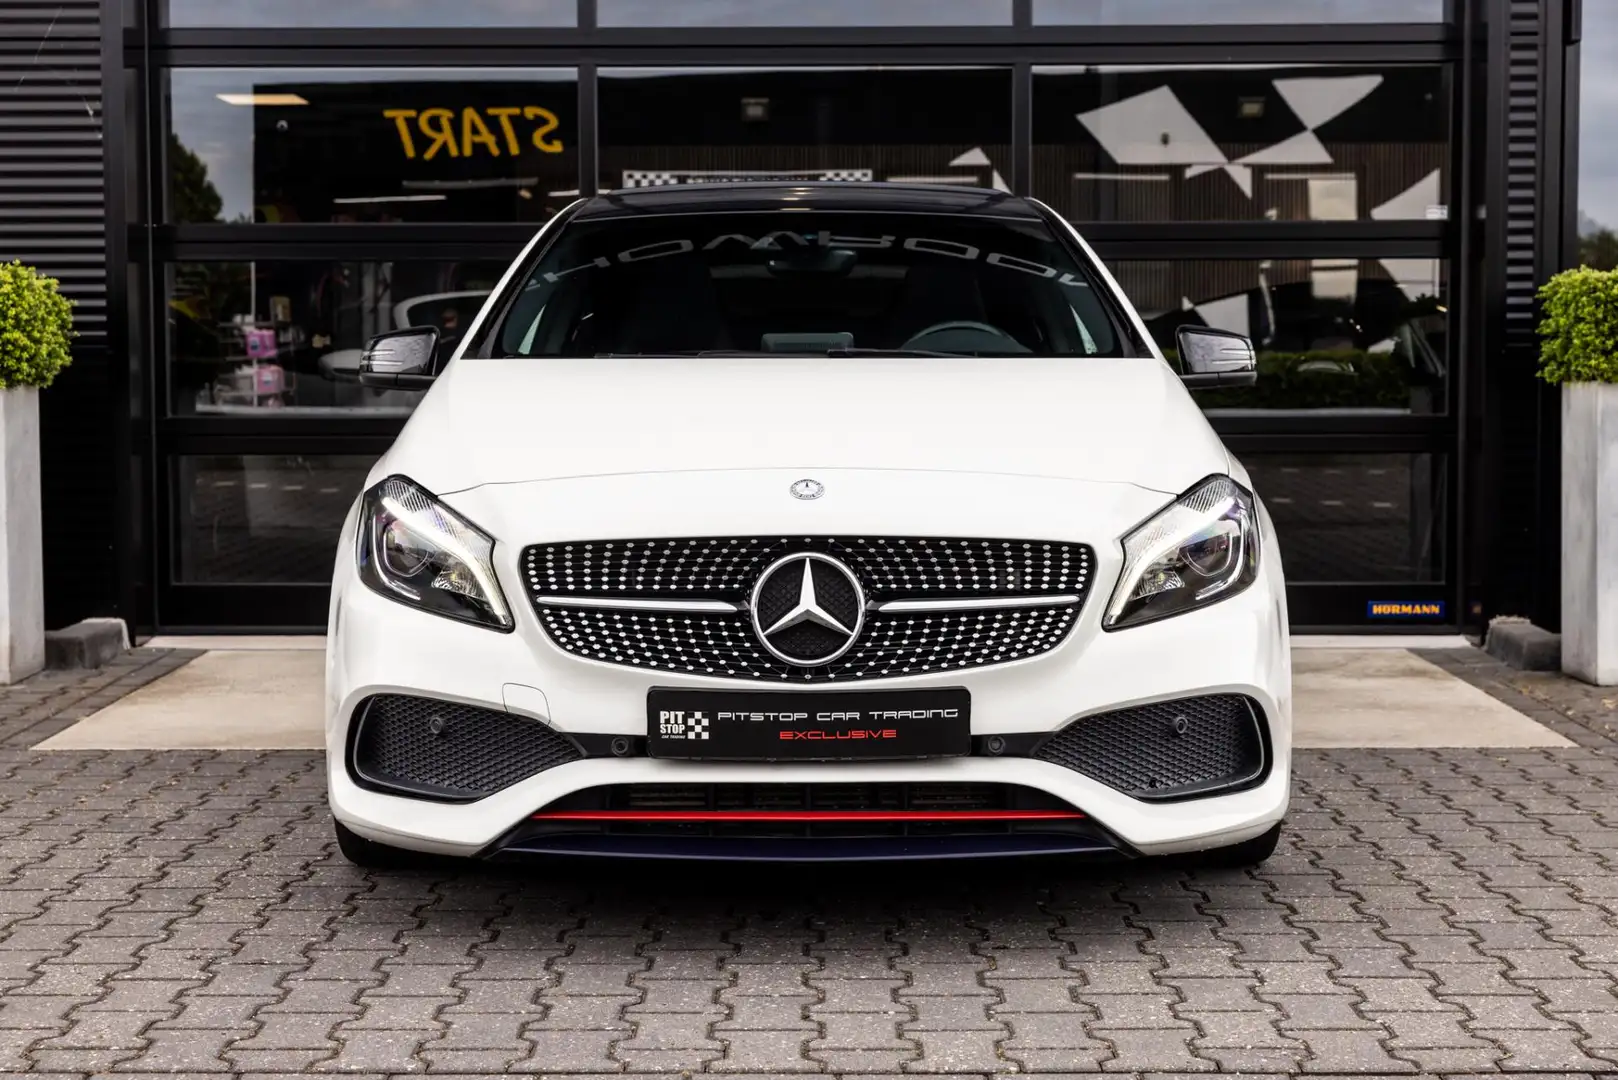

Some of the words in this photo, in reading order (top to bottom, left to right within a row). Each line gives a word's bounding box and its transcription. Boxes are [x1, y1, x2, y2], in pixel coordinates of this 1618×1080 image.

[660, 710, 685, 724] PIT
[717, 711, 808, 722] PITSTOP
[816, 711, 861, 721] CAR
[868, 708, 959, 720] TRADING
[660, 723, 685, 734] STOP
[779, 729, 897, 740] EXCLUSIVE
